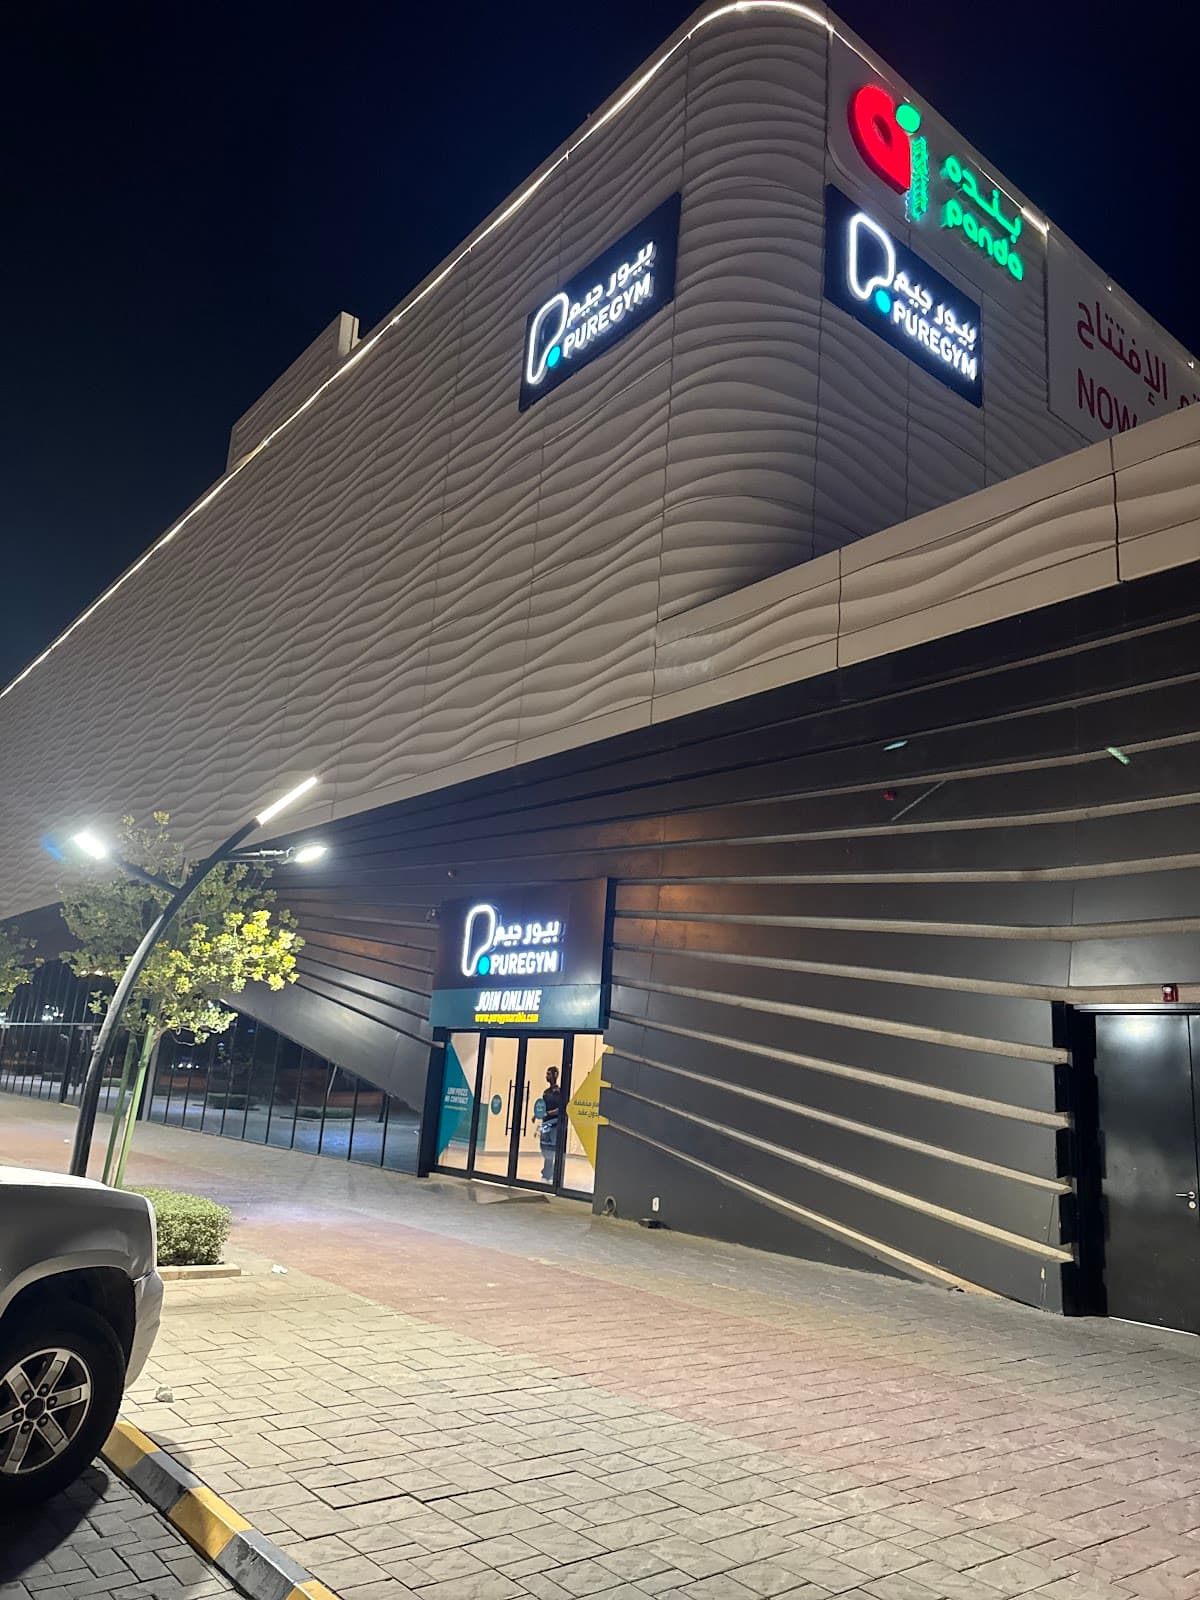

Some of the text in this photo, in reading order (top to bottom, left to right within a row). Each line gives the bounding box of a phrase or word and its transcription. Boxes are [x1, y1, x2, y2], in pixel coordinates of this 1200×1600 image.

[945, 198, 1024, 281] panda
[563, 271, 653, 358] PUREGYM
[566, 241, 655, 328] بيور جيم
[893, 271, 977, 351] بيور جيم
[893, 300, 978, 381] PUREGYM
[1078, 367, 1138, 433] NOW
[490, 951, 559, 976] PUREGYM
[493, 920, 561, 947] بيور جيم
[475, 990, 542, 1012] JOIN ONLINE
